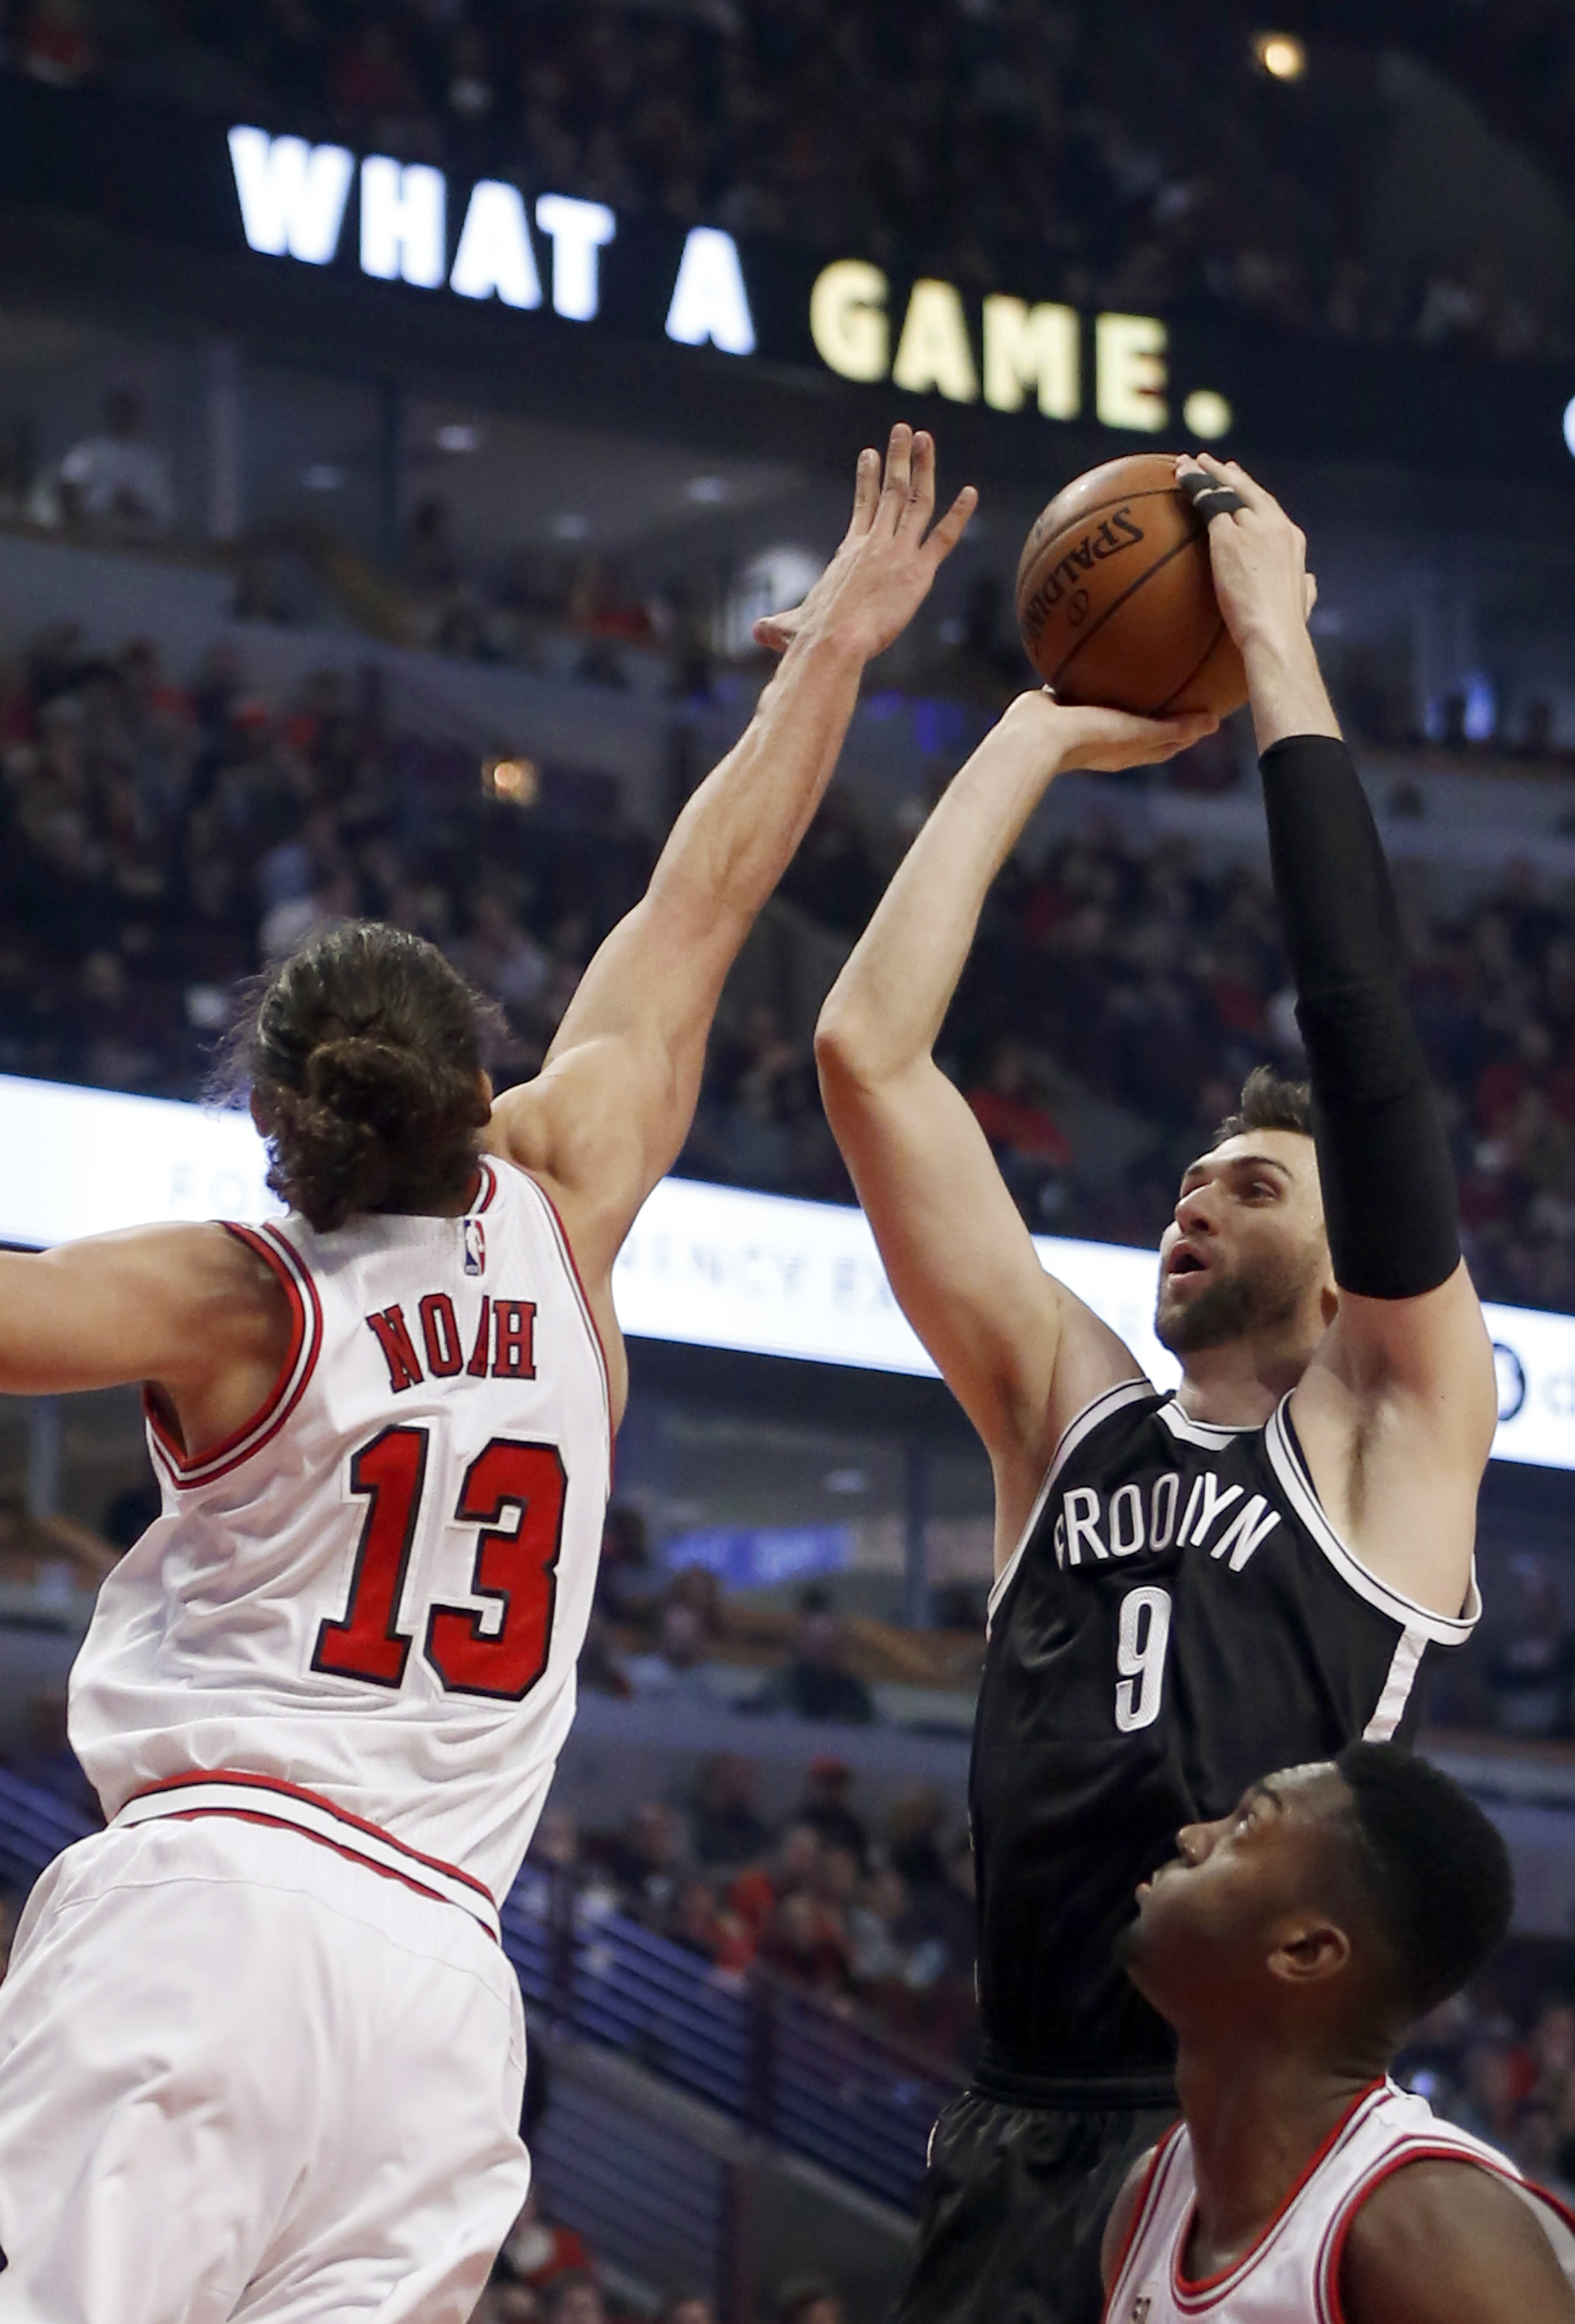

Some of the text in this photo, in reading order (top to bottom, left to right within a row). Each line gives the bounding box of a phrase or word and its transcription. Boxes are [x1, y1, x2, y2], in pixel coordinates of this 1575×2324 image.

[227, 123, 1233, 441] WHAT A GAME.
[310, 1423, 568, 1702] 13
[1114, 1585, 1172, 1733] 9
